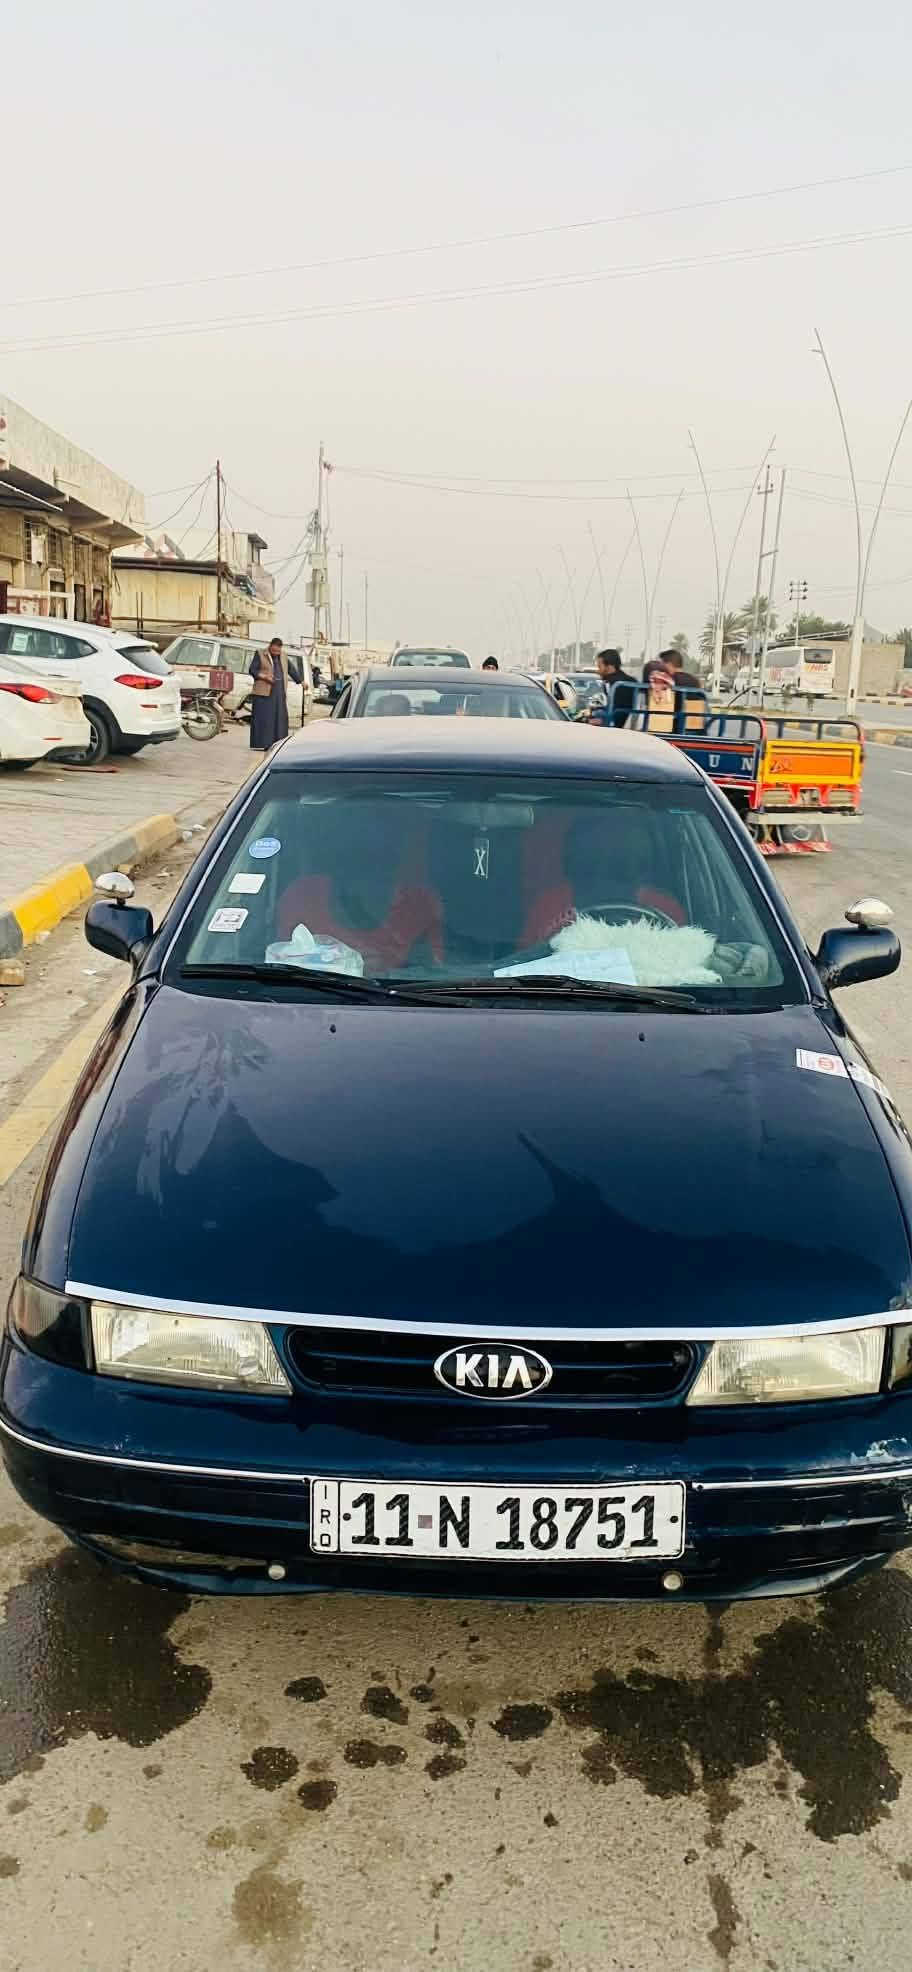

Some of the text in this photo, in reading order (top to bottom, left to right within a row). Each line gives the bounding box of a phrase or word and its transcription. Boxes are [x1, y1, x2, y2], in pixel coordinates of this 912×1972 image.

[455, 1353, 533, 1388] KIA
[352, 1492, 658, 1550] 11 N 18751
